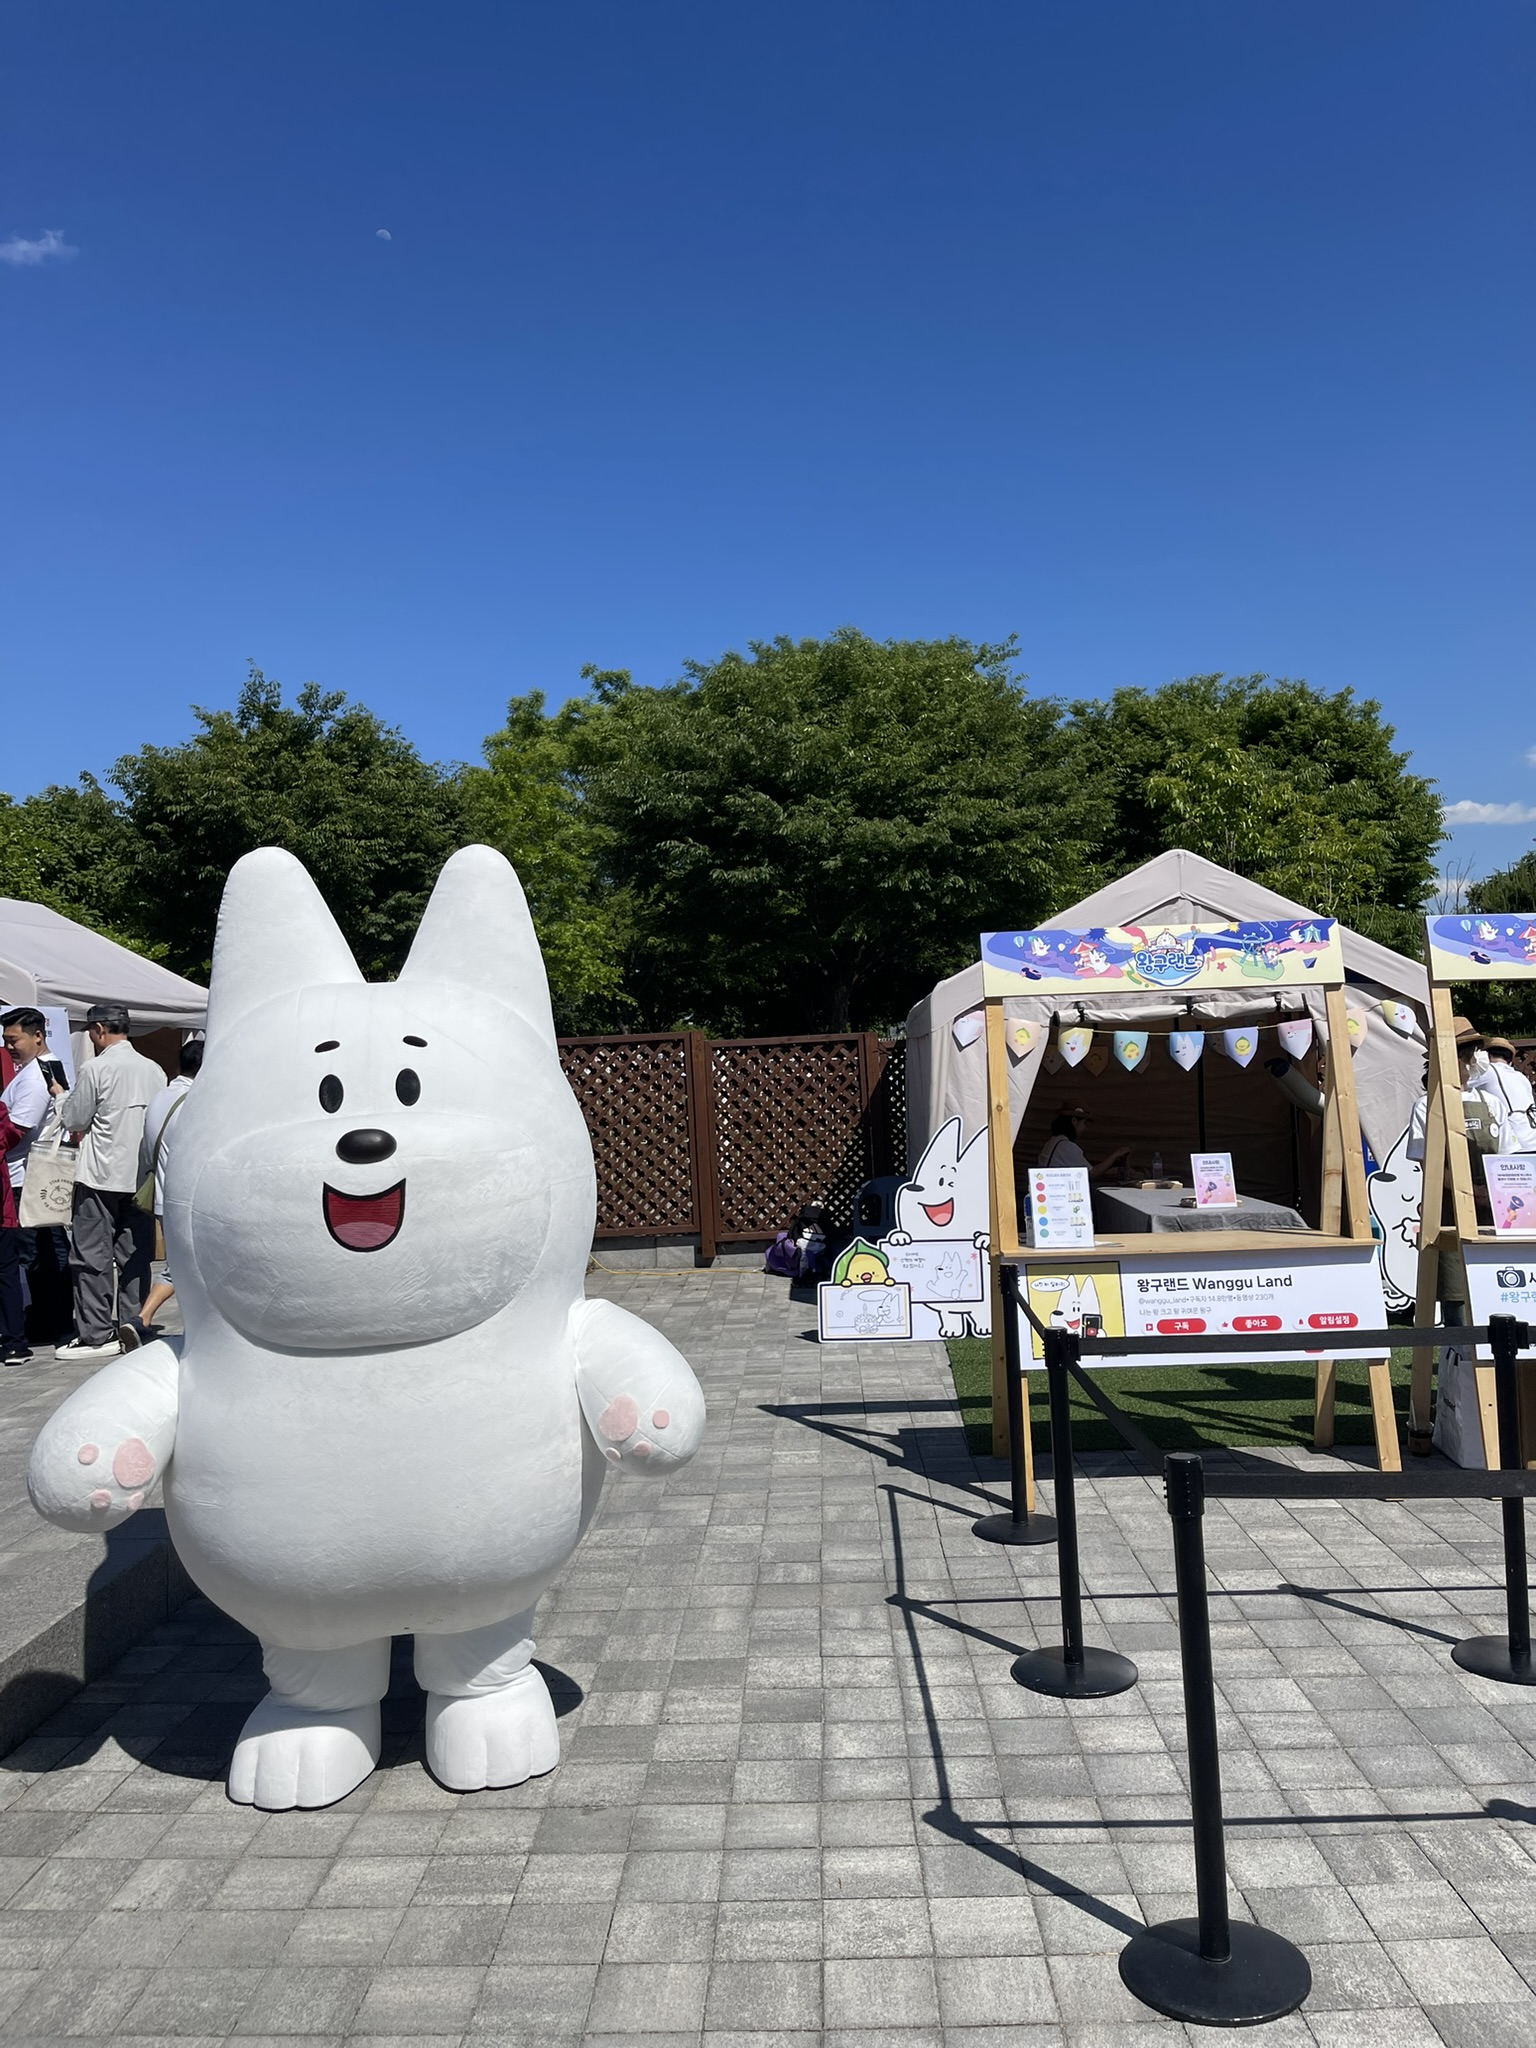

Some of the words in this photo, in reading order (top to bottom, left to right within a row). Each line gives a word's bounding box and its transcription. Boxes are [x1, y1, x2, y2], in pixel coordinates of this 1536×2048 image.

[1136, 952, 1198, 972] 왕구랜드
[1137, 1278, 1190, 1293] 왕구랜드
[1192, 1277, 1253, 1291] Wanggu
[1257, 1274, 1293, 1288] Land
[1255, 1293, 1274, 1301] 230개
[1139, 1308, 1151, 1316] 나는
[1181, 1307, 1198, 1315] 귀여운
[1174, 1321, 1190, 1331] 구독
[1245, 1319, 1268, 1329] 좋아요
[1319, 1315, 1350, 1325] 알림설정
